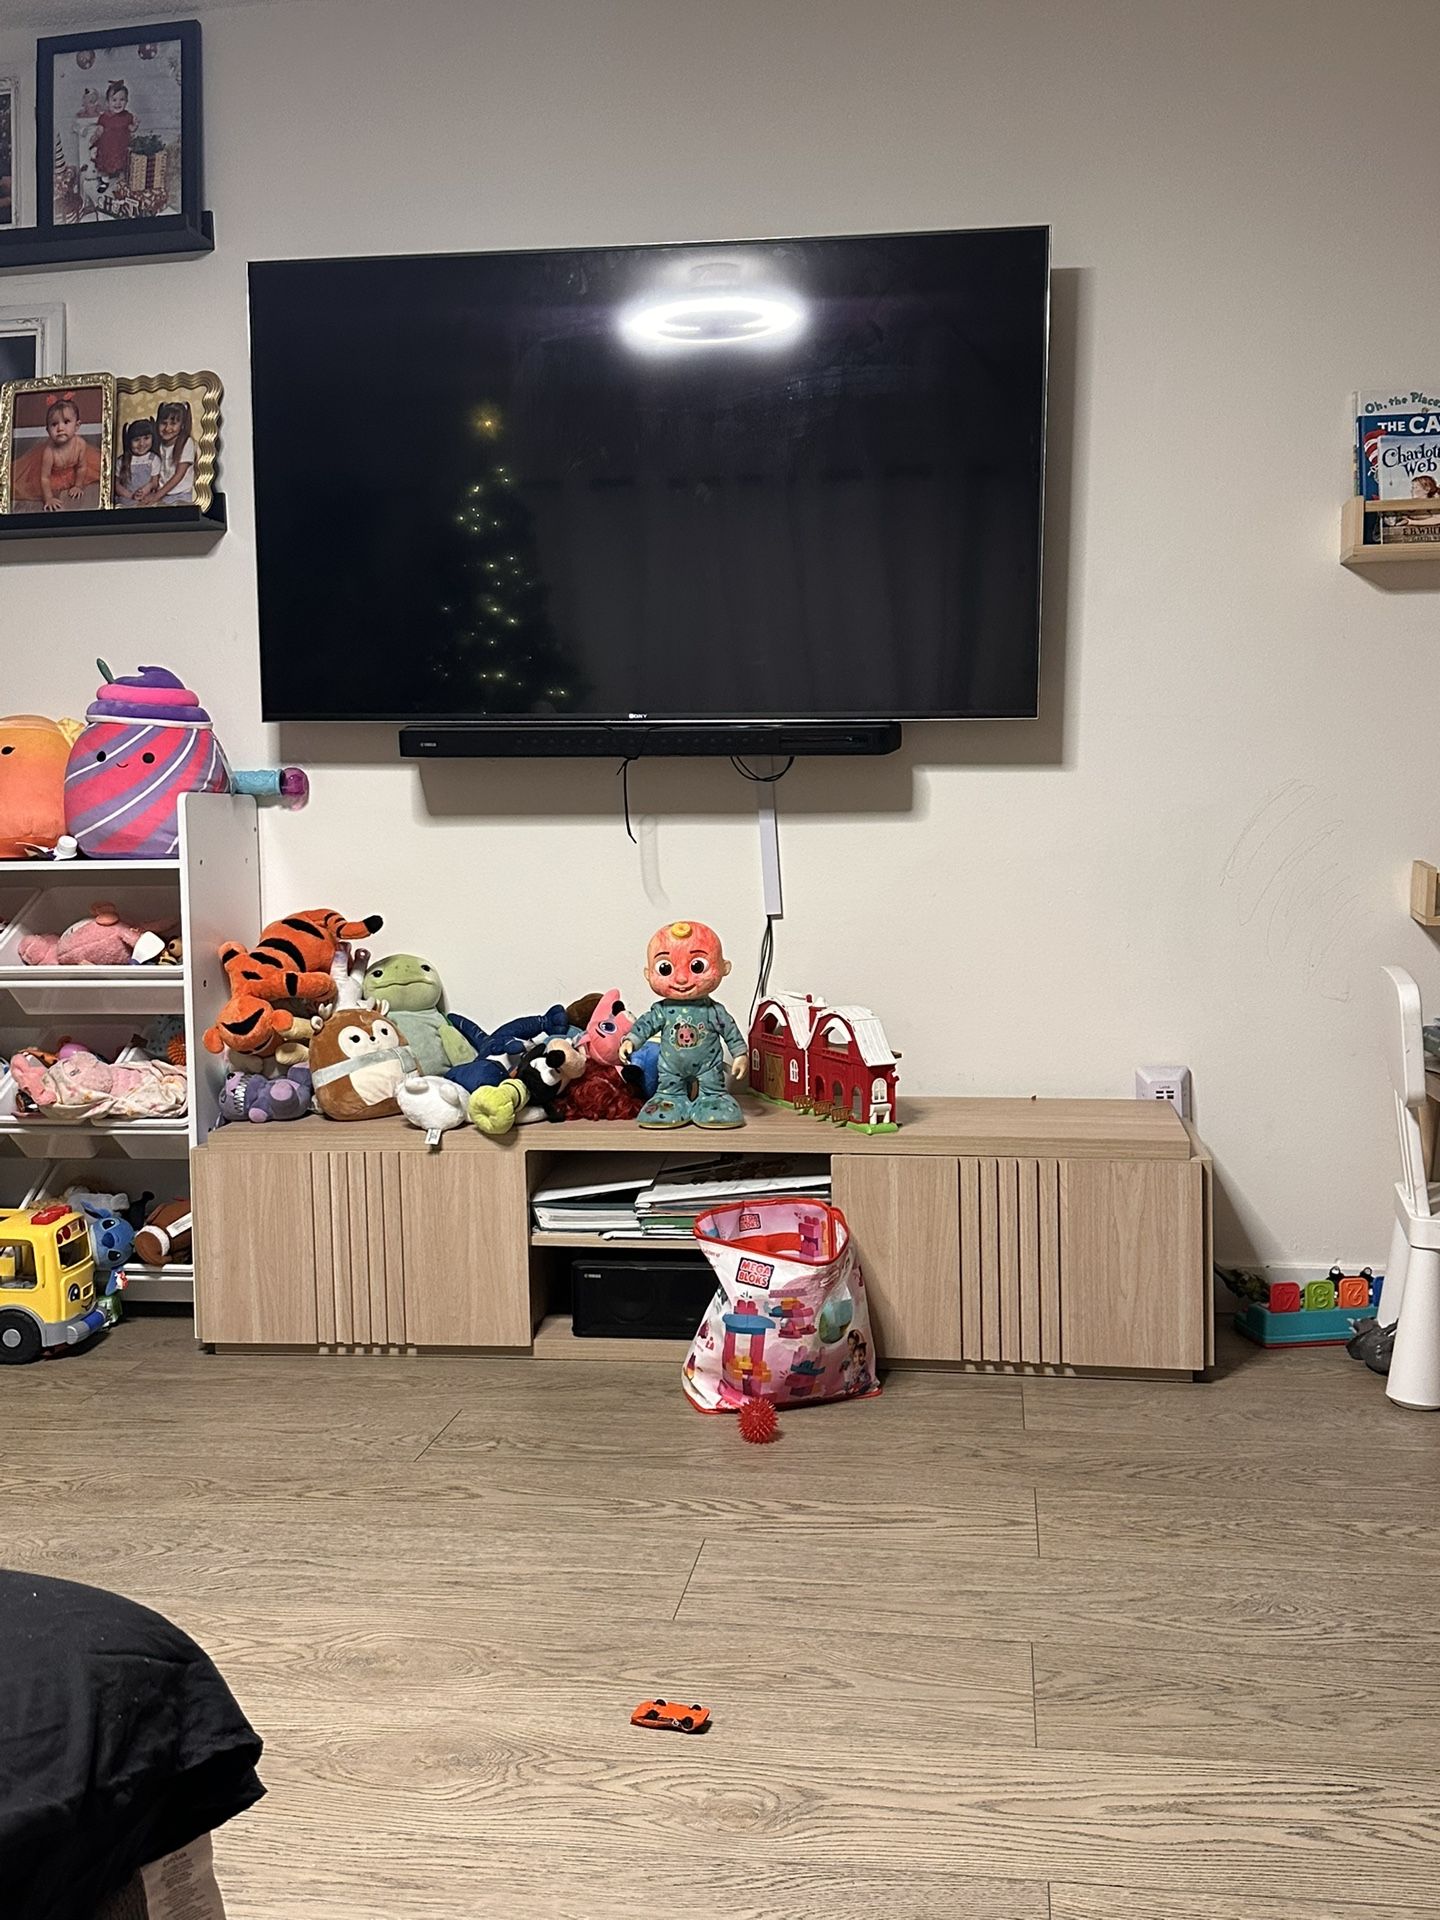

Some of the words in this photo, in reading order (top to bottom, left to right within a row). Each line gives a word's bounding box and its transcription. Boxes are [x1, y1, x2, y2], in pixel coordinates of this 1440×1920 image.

[1365, 402, 1387, 414] Oh,
[1389, 396, 1407, 406] the
[1377, 421, 1406, 432] THE
[1409, 415, 1440, 434] CA
[1401, 457, 1437, 477] Web
[741, 1260, 771, 1276] MEGA
[738, 1271, 769, 1287] BLOKS
